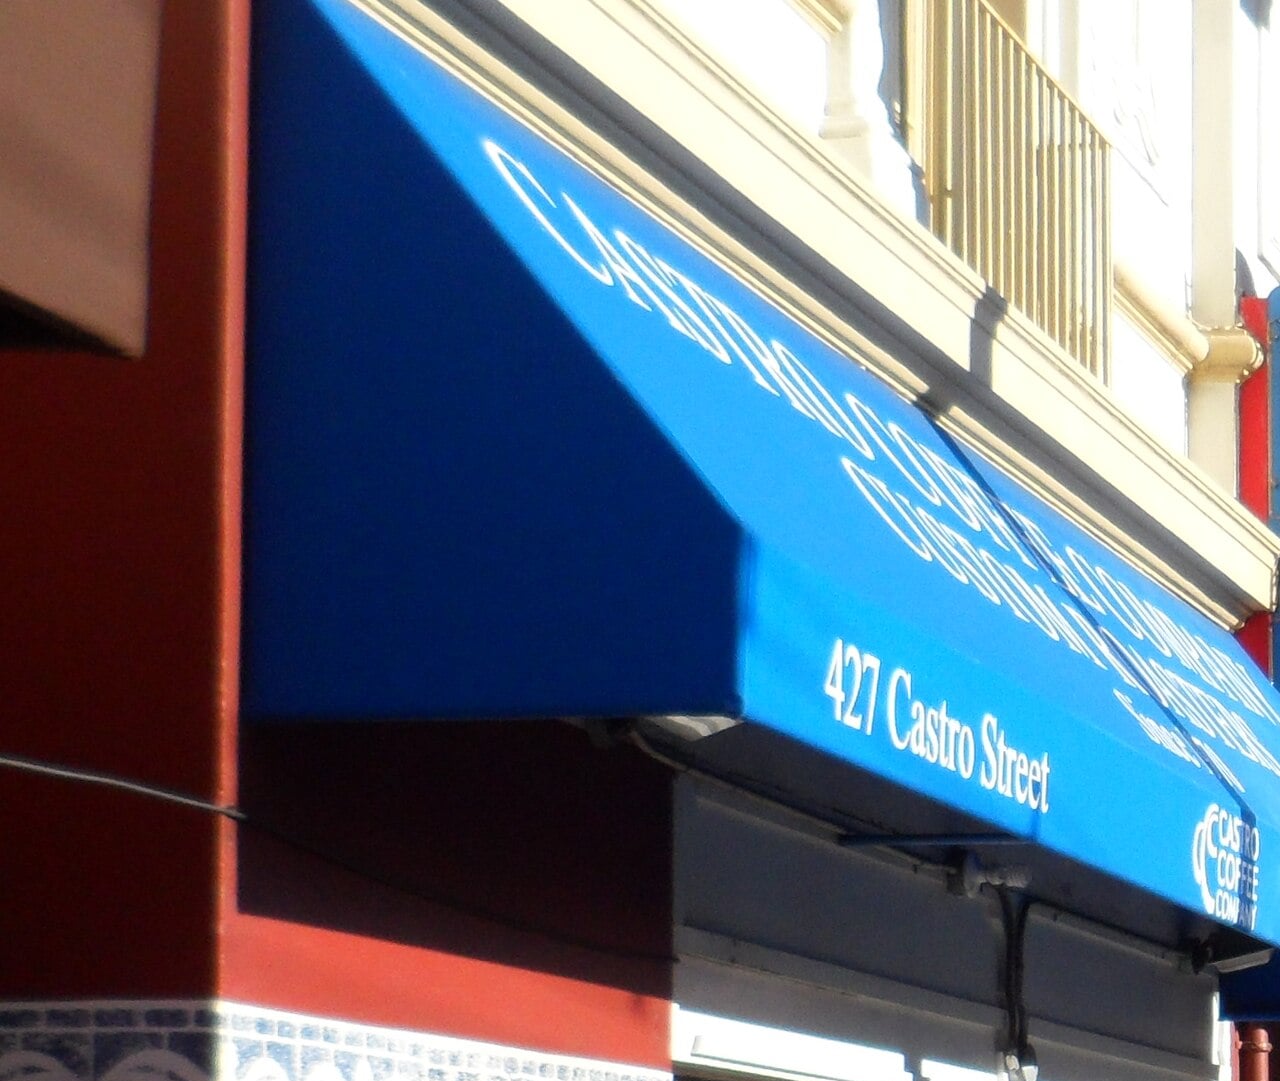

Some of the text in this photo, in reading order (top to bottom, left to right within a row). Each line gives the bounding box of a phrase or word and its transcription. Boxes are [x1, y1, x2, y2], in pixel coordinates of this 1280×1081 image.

[483, 139, 876, 461] CASTRO
[846, 393, 1108, 615] COFFEE
[841, 456, 1108, 671] CUSTOM
[824, 637, 1050, 814] 427 Castro Street
[1216, 849, 1260, 902] COFFEE
[1218, 809, 1260, 862] CASTRO
[1214, 889, 1258, 931] COMPANY
